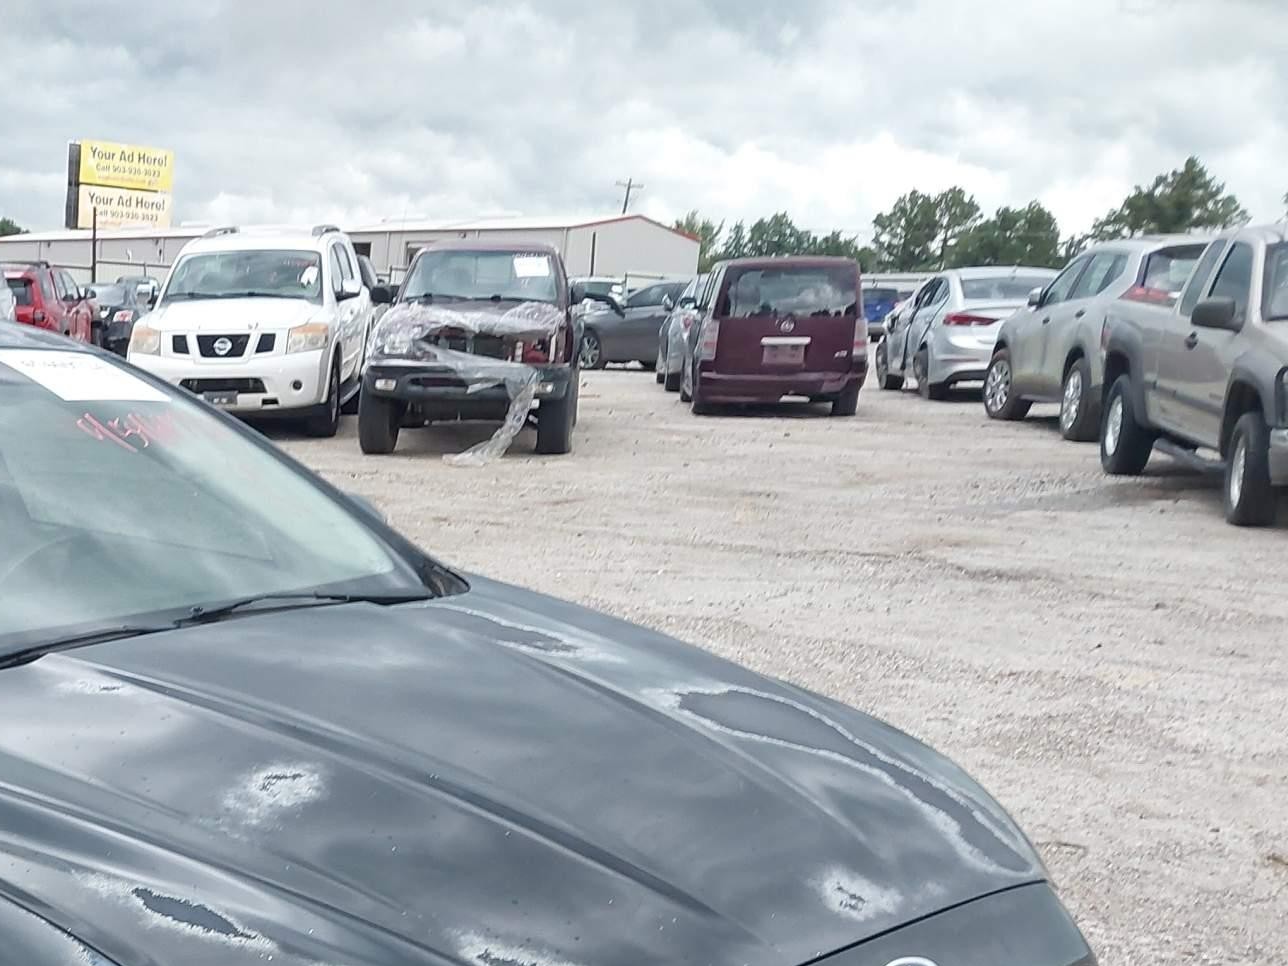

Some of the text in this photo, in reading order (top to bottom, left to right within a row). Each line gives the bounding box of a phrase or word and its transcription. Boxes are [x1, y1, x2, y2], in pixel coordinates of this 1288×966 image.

[91, 146, 116, 160] Your
[119, 150, 134, 163] Ad
[89, 192, 114, 206] Your
[117, 195, 132, 208] Ad
